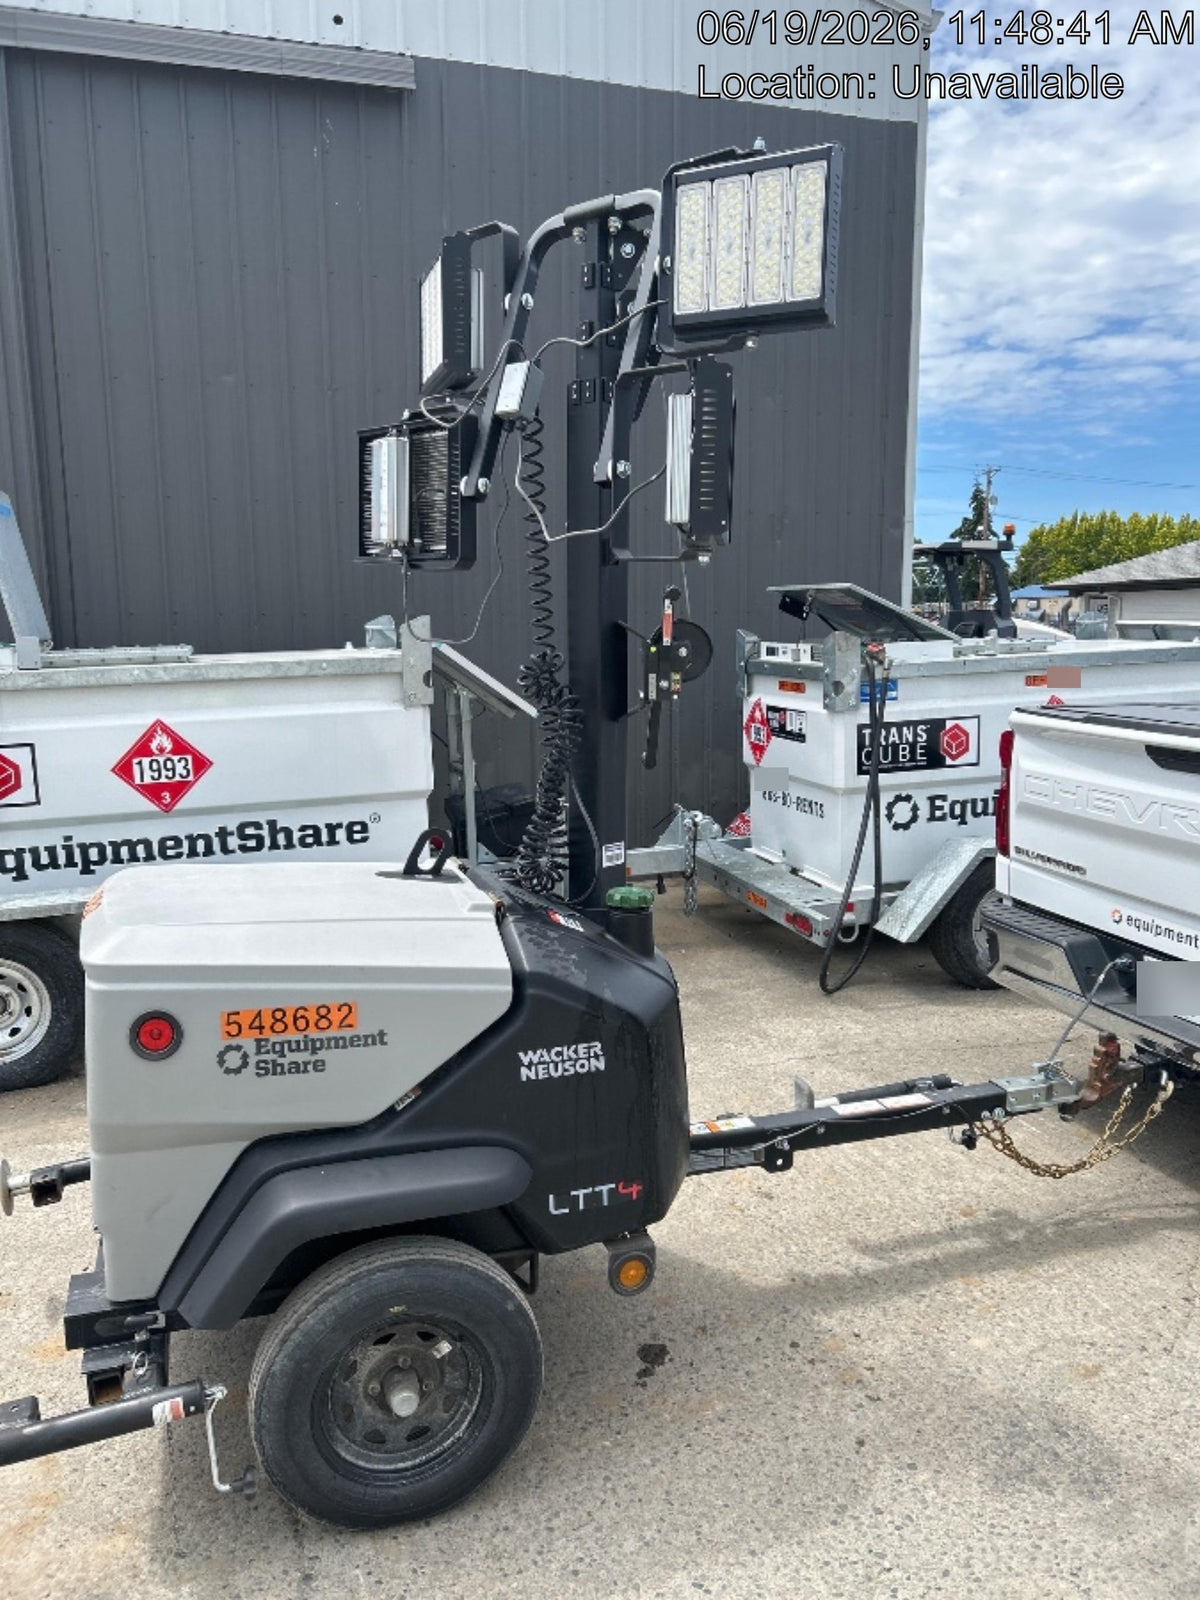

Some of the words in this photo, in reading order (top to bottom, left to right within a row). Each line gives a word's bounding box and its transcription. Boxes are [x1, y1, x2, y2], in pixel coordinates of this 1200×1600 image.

[862, 724, 927, 746] TRANS
[862, 742, 927, 765] CUBE
[135, 757, 191, 782] 1993
[161, 792, 171, 804] 3
[1126, 913, 1200, 950] equipment
[225, 1002, 355, 1038] 548682
[254, 1029, 389, 1058] Equipment
[518, 1041, 604, 1066] WACKER
[254, 1058, 327, 1078] Share
[520, 1055, 606, 1082] NEUSON
[548, 1180, 643, 1216] LTT4
